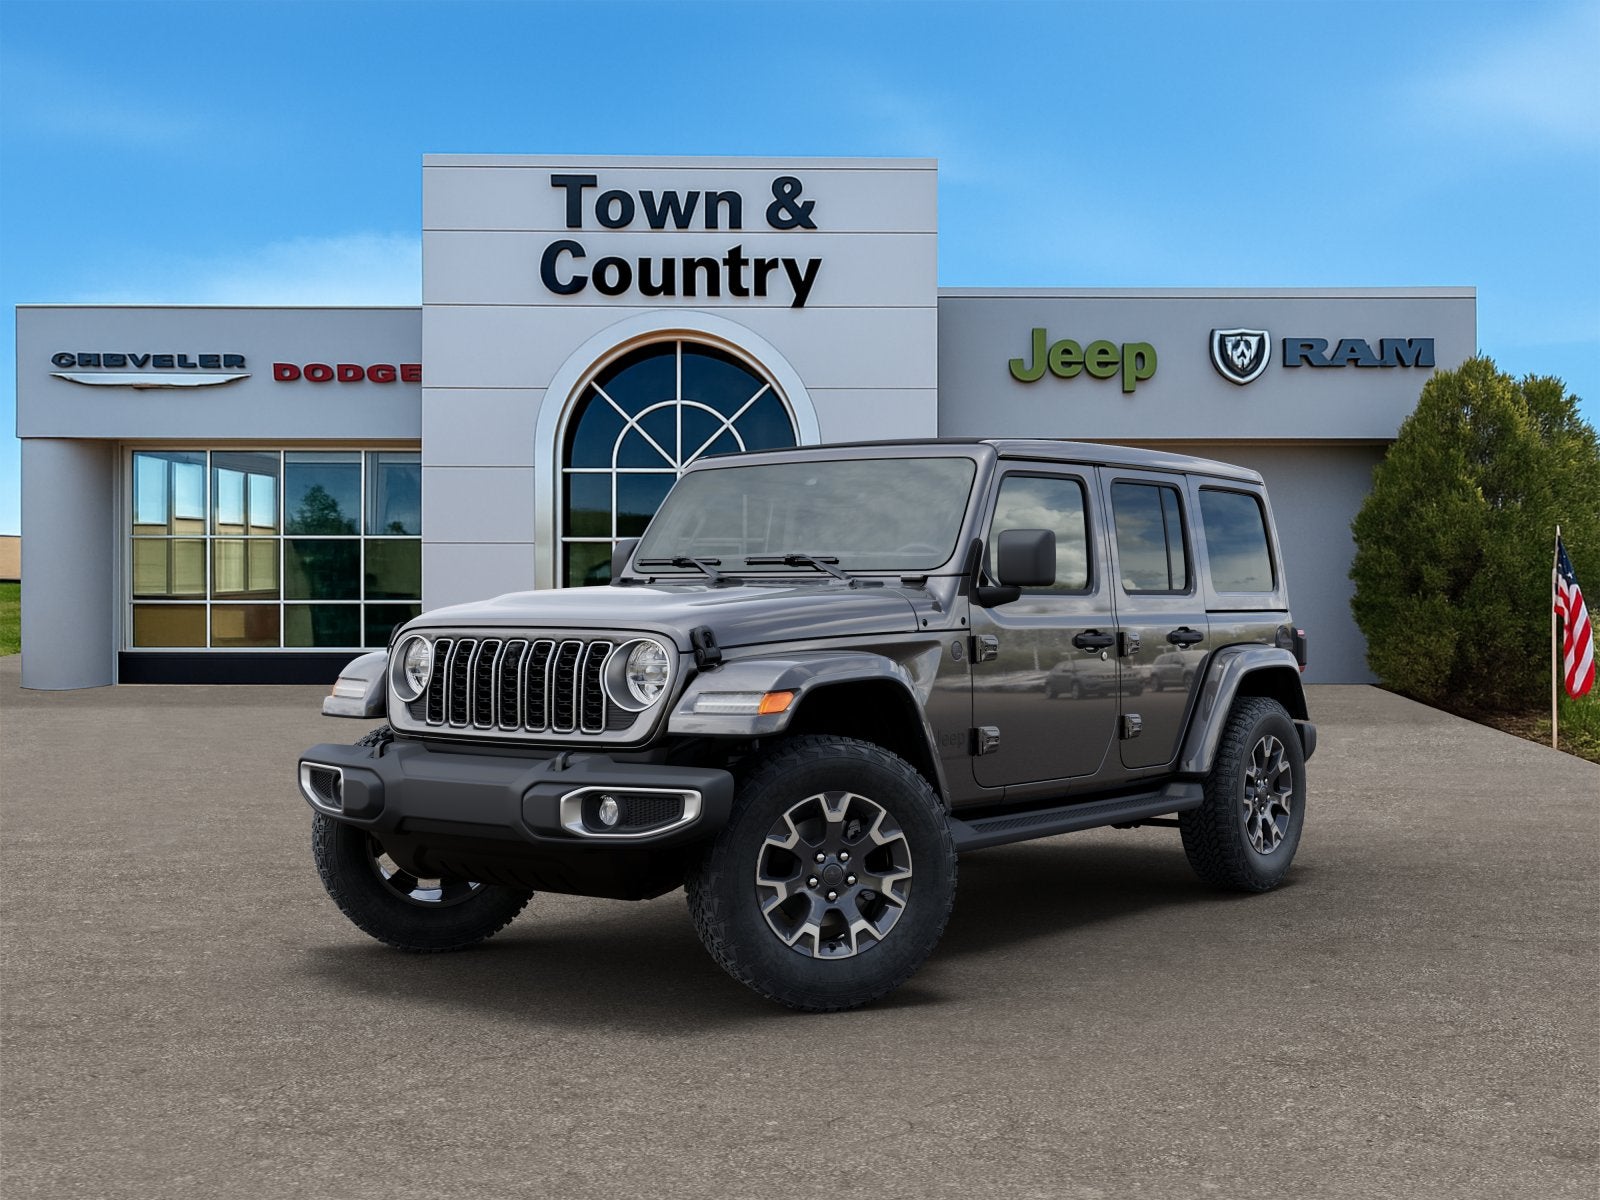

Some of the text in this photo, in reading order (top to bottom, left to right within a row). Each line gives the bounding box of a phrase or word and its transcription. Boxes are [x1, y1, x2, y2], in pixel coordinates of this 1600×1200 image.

[550, 174, 818, 230] Town &
[539, 239, 823, 308] Country
[273, 362, 421, 384] DODGE
[1009, 328, 1158, 393] Jeep
[1283, 337, 1435, 368] RAM
